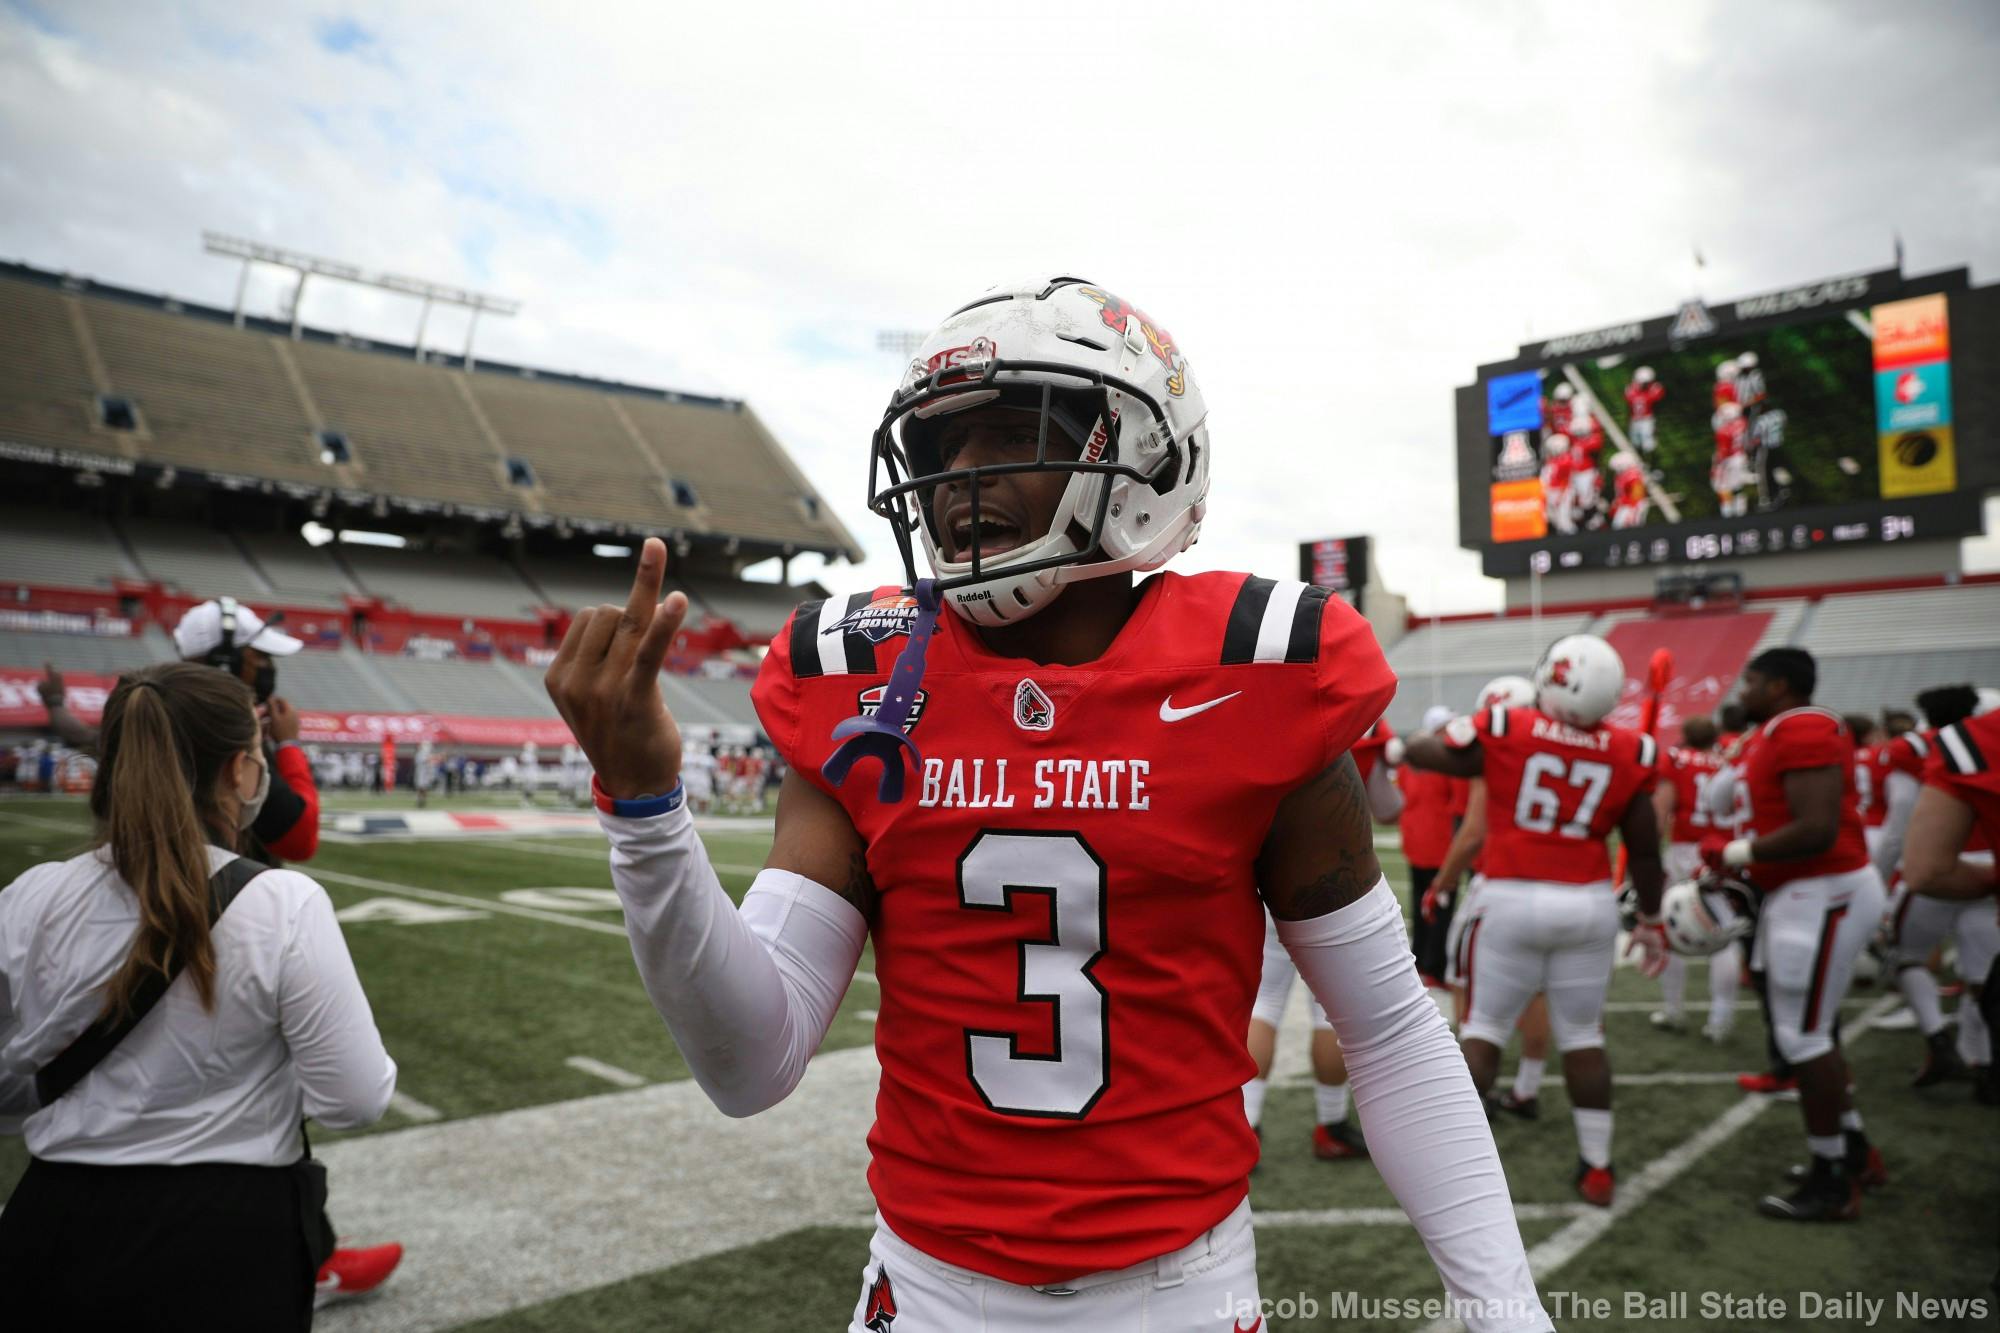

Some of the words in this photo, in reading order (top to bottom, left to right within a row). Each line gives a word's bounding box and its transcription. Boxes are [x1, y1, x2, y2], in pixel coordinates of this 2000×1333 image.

[956, 590, 993, 603] Riddell
[849, 607, 919, 621] ARIZONA
[857, 618, 905, 630] BOWL
[918, 758, 1015, 809] BALL
[1034, 758, 1151, 811] STATE
[1514, 752, 1612, 840] 67
[956, 828, 1111, 1121] 3
